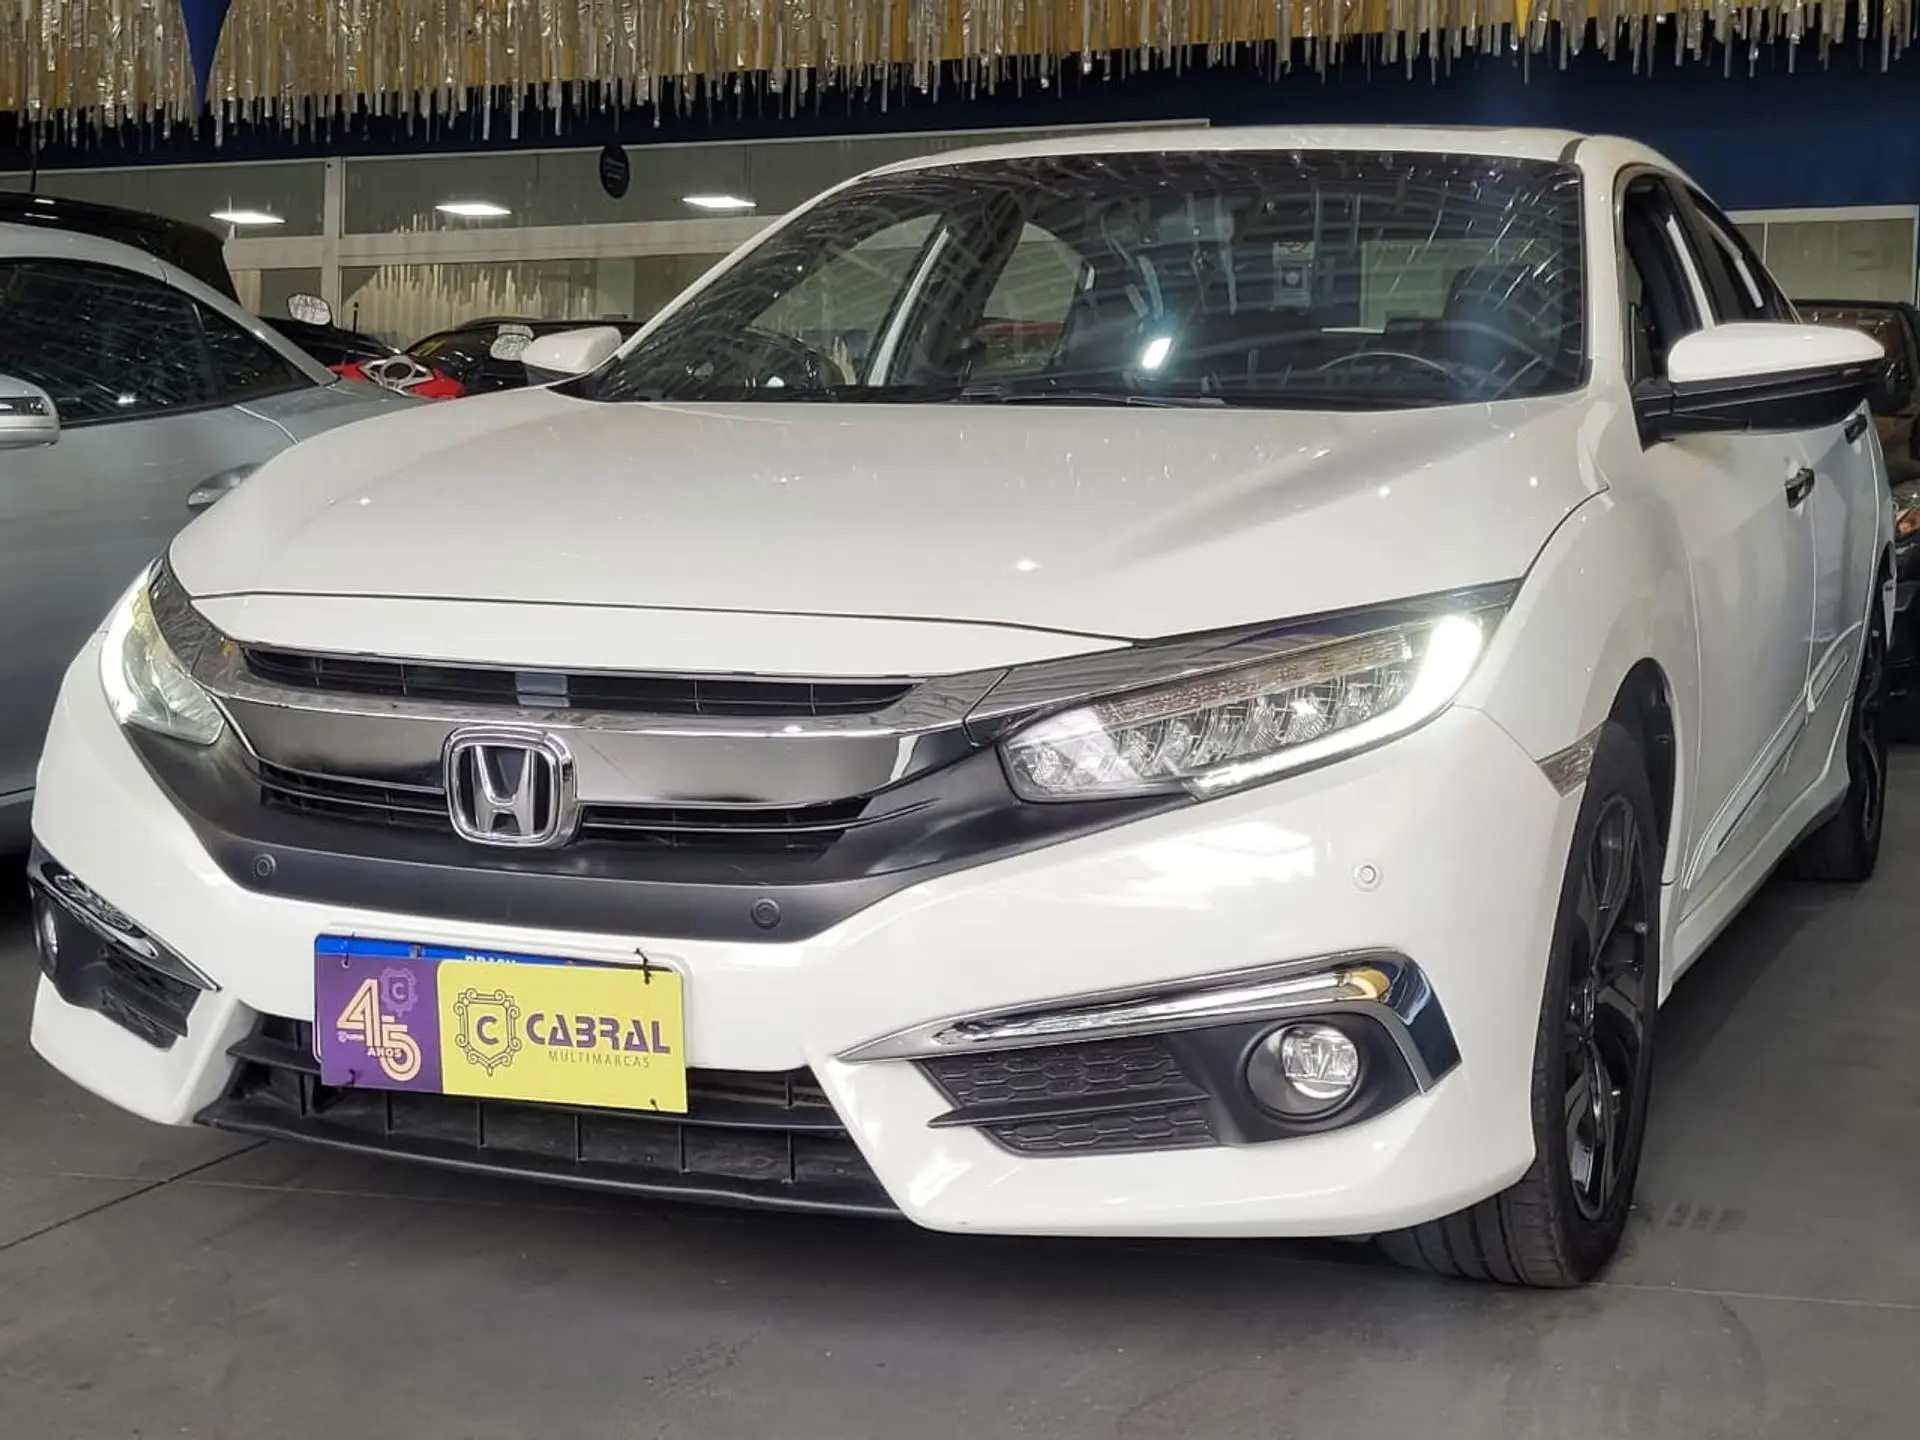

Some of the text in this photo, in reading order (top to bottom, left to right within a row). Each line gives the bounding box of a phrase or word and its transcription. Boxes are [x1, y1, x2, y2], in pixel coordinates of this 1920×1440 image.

[336, 978, 422, 1082] 45
[476, 1016, 499, 1045] C
[526, 1013, 671, 1054] CABRAL
[548, 1050, 650, 1069] MULTIMARCAS
